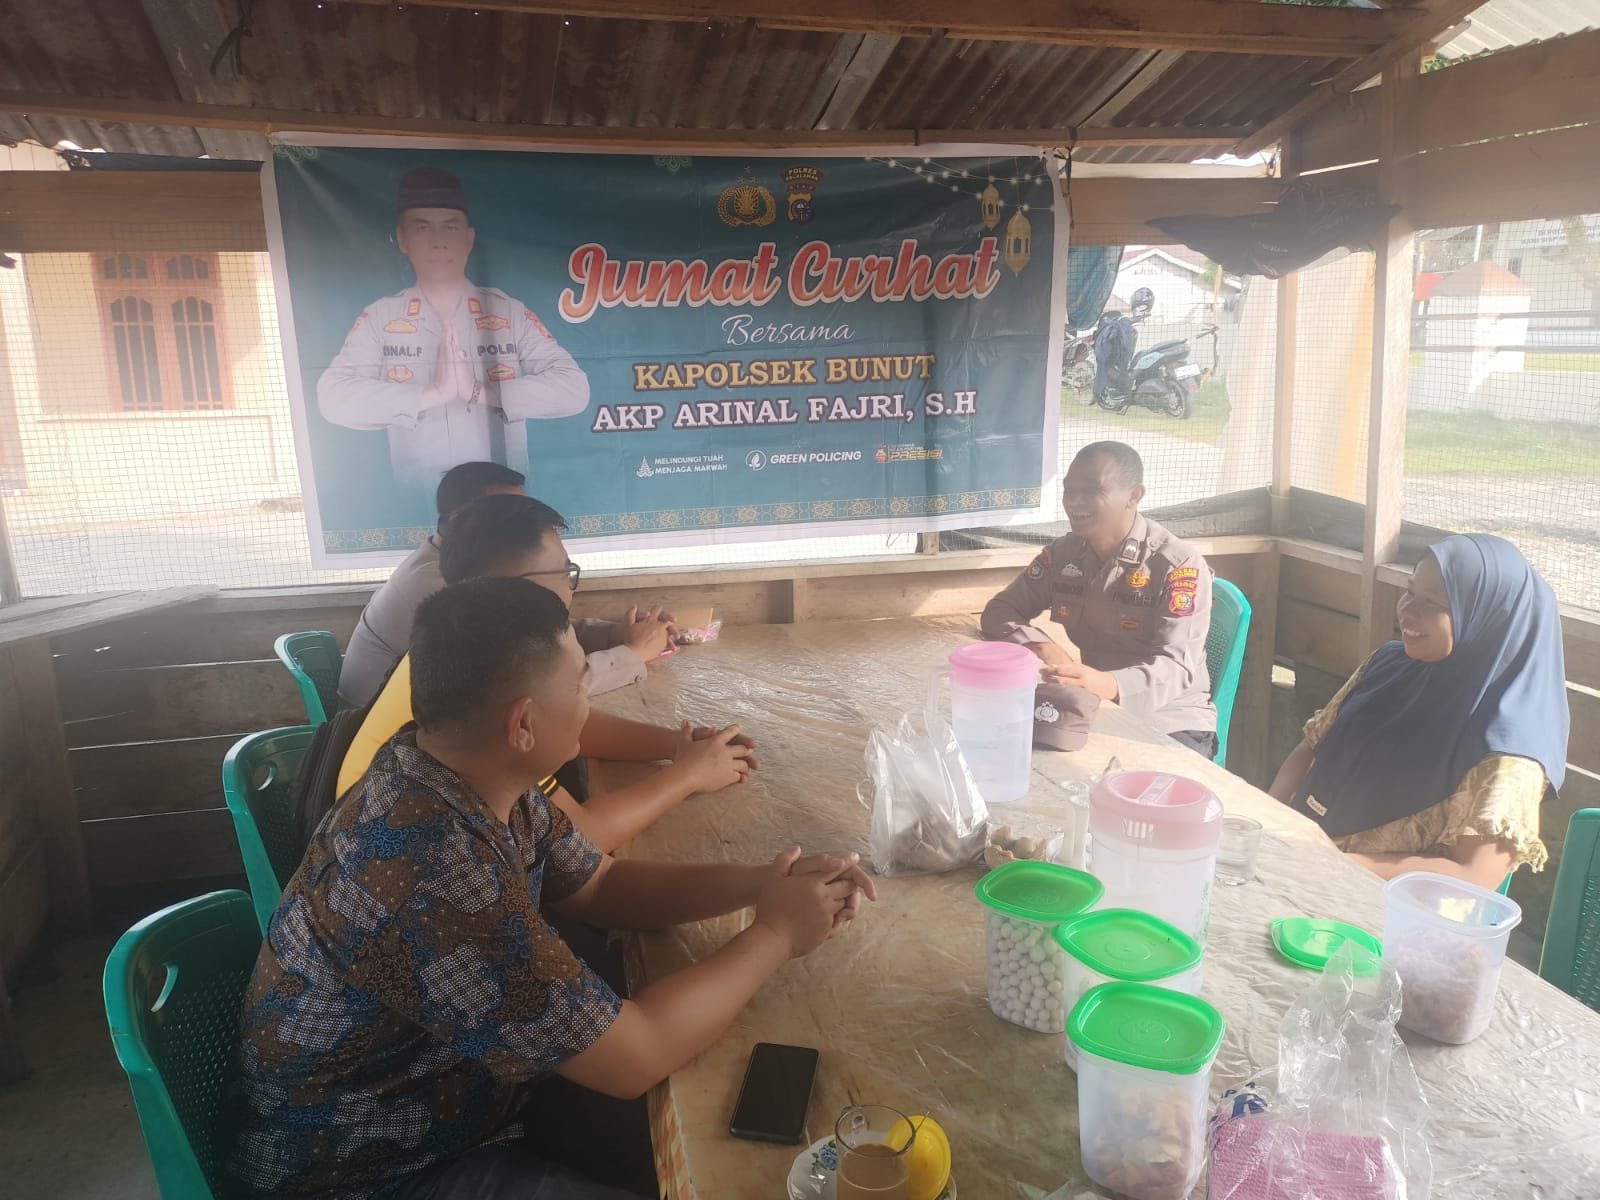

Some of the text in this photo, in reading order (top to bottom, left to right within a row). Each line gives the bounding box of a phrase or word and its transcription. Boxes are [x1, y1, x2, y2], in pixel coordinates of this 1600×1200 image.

[788, 167, 817, 175] POLRES
[558, 237, 1001, 323] Jumat Curhat
[721, 314, 855, 344] Bersama
[477, 344, 517, 356] POLRI
[634, 354, 935, 391] KAPOLSEK BUNUT
[592, 391, 977, 432] AKP ARINAL FAJRI, S.H
[654, 454, 724, 465] MELINDUNGI TUAH
[770, 450, 862, 465] GREEN POLICING
[655, 463, 728, 475] MENJAGA MARWAH
